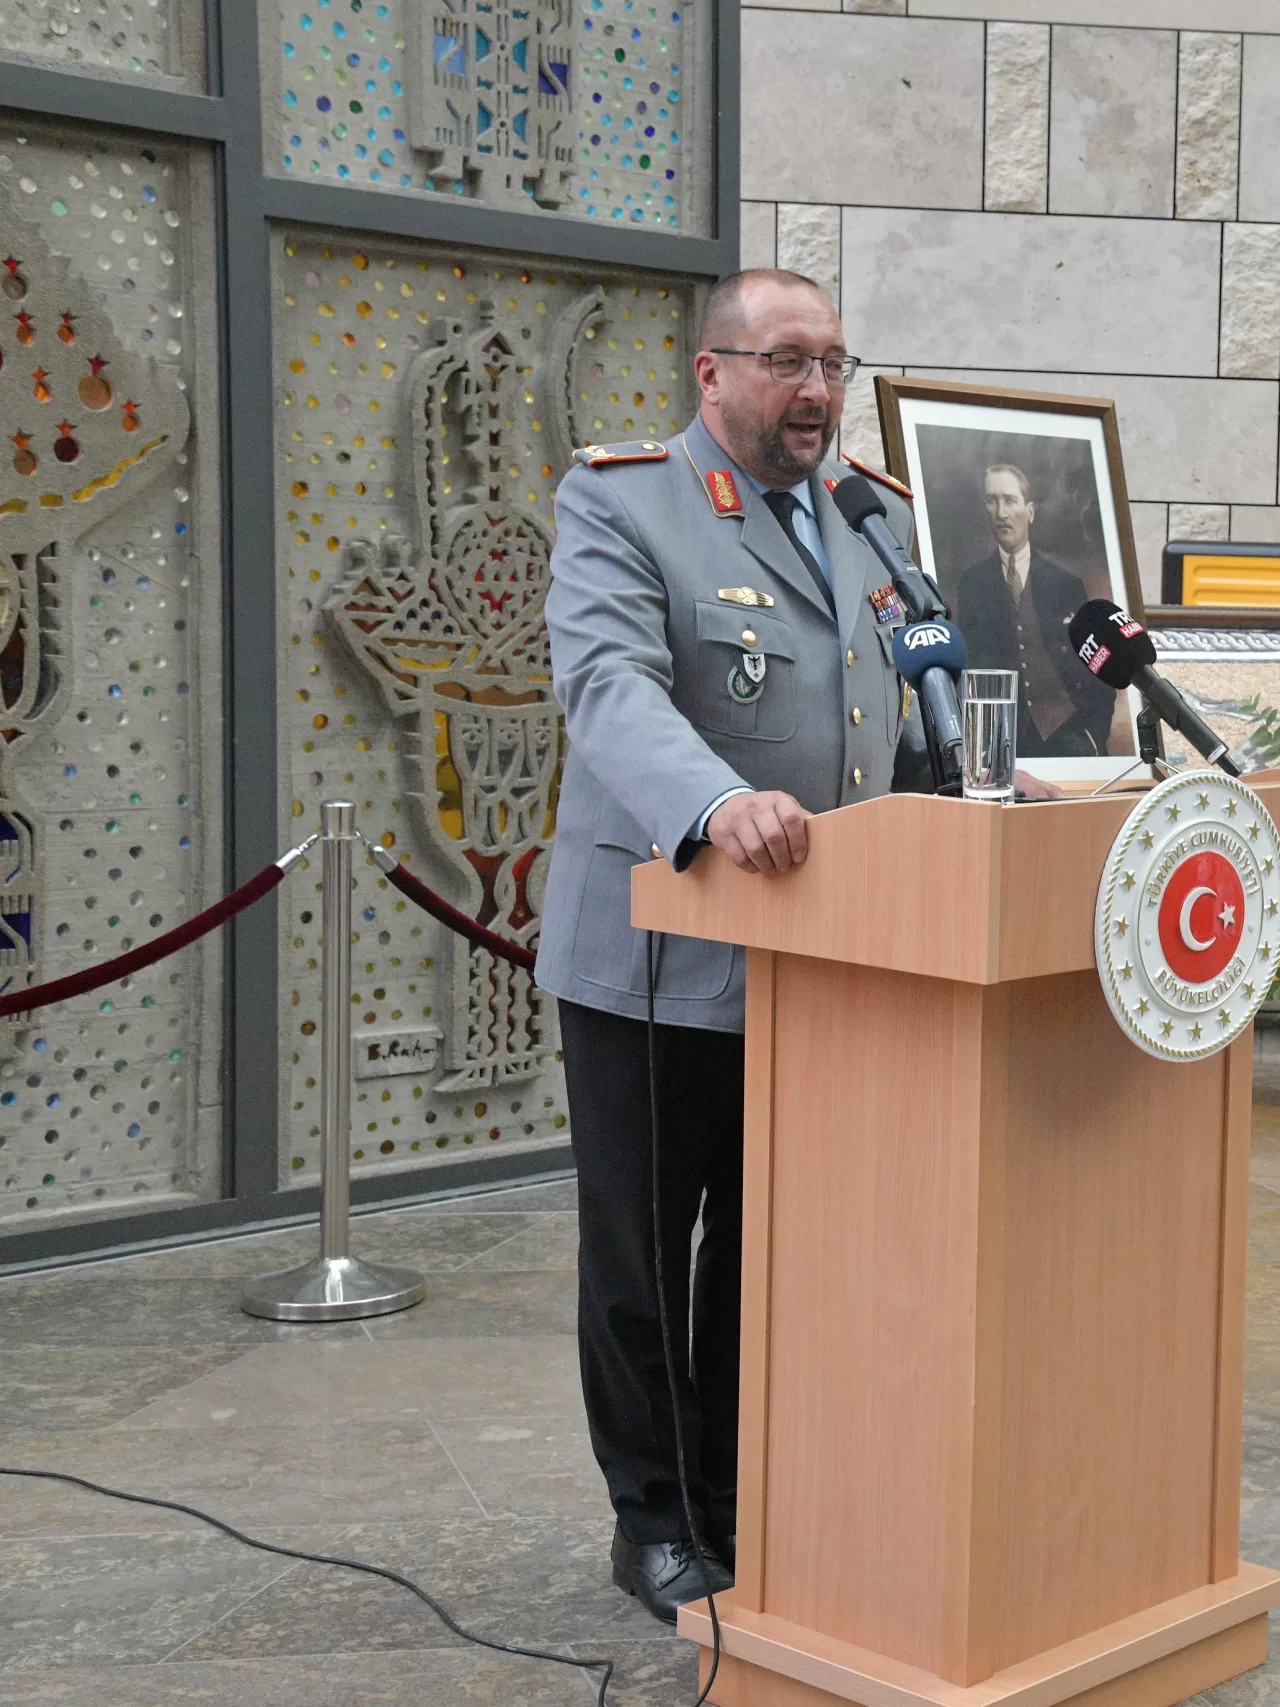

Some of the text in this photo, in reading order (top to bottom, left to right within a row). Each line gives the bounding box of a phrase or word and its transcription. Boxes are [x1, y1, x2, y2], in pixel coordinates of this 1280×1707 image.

[1108, 611, 1135, 626] TR
[908, 628, 951, 651] AA
[1078, 633, 1099, 664] TRT
[1089, 647, 1110, 674] HABER
[1146, 830, 1261, 906] TÜRKİYE CUMHURİYETİ
[1156, 956, 1246, 1005] BÜYÜKELÇİLİĞİ
